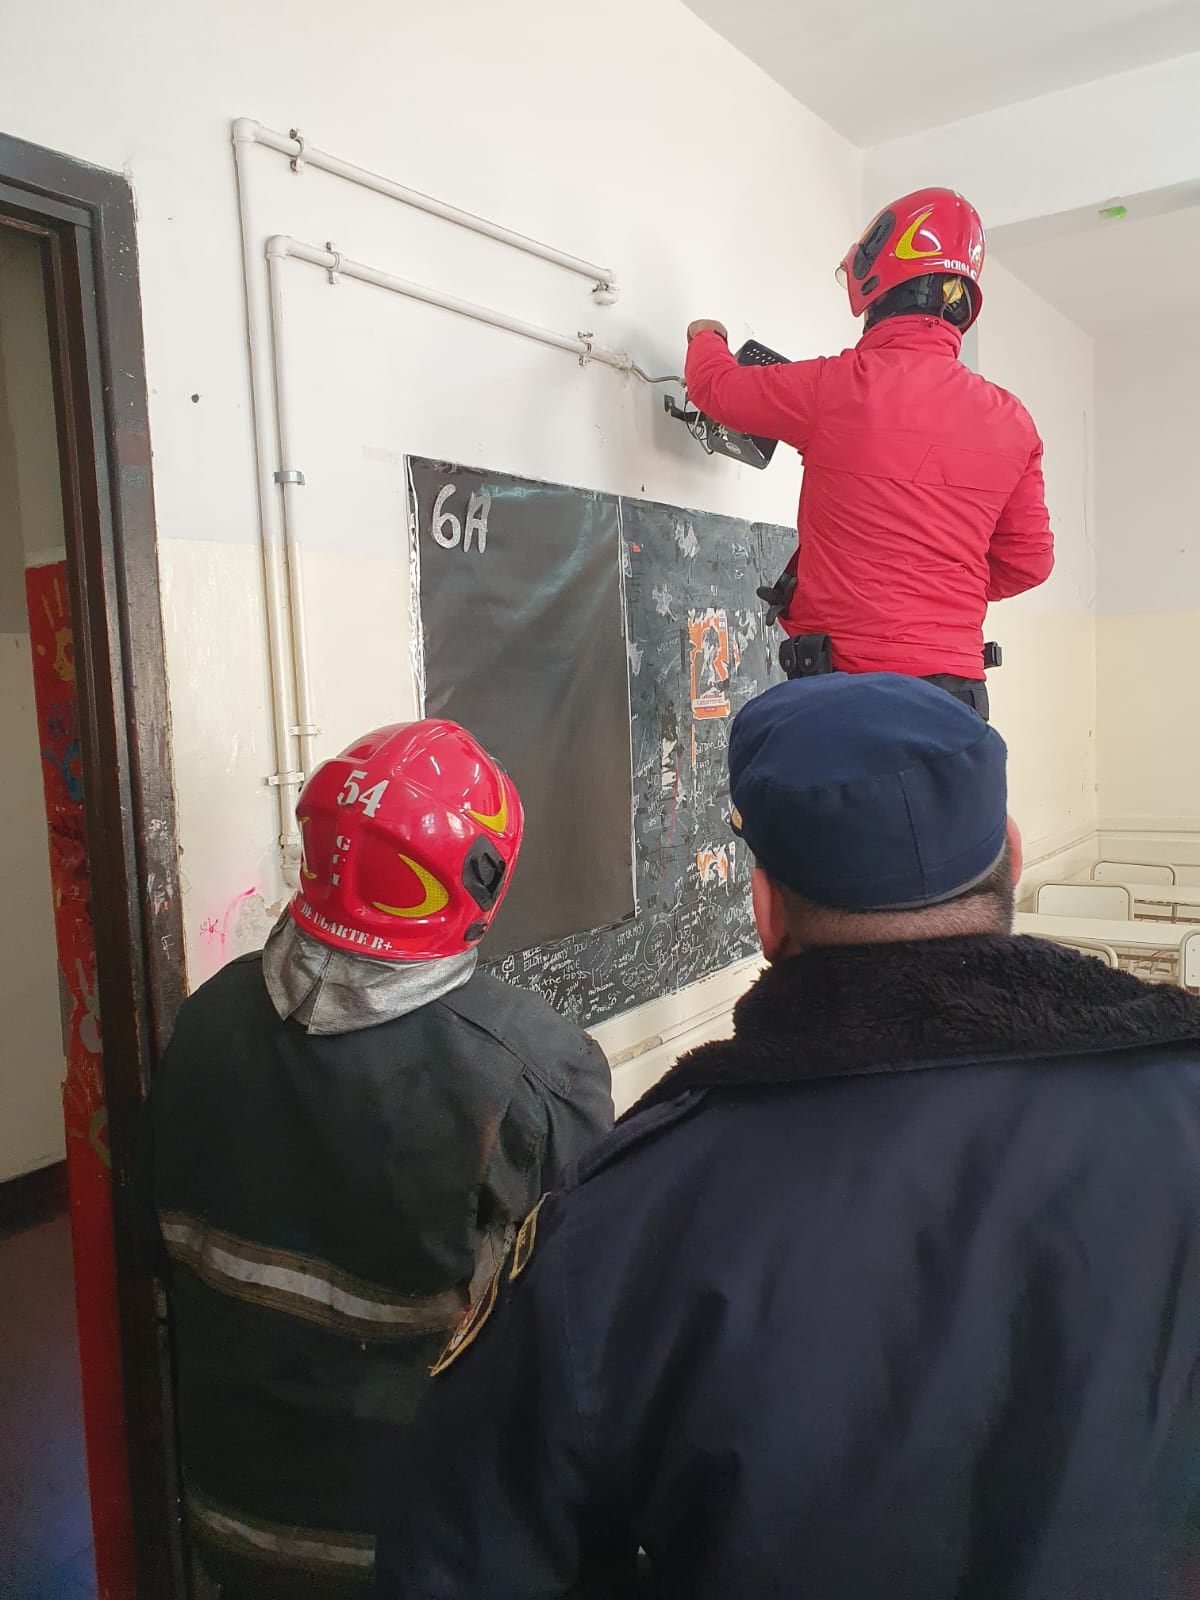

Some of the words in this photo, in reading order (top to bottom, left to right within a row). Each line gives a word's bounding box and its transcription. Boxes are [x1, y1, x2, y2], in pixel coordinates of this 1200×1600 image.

[432, 484, 492, 554] 6A
[336, 769, 390, 818] 54
[313, 911, 370, 945] UGARTE
[371, 936, 393, 950] B+
